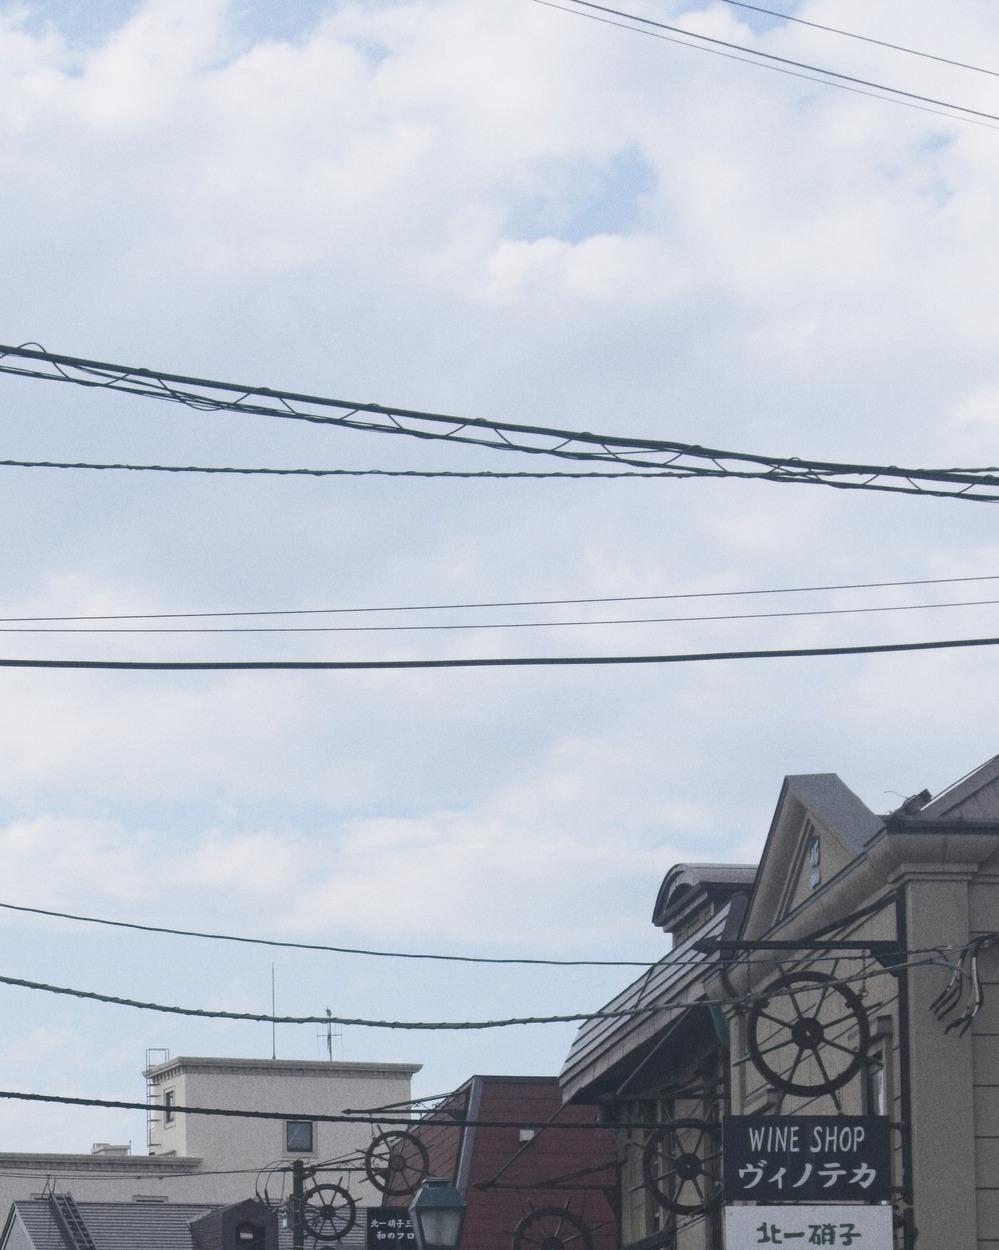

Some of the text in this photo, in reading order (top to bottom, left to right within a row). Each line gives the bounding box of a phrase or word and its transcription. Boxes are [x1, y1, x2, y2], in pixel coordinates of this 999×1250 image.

[748, 1125, 865, 1153] WINE SHOP
[737, 1160, 877, 1189] ヴィノテカ
[756, 1222, 862, 1246] 北一硝子
